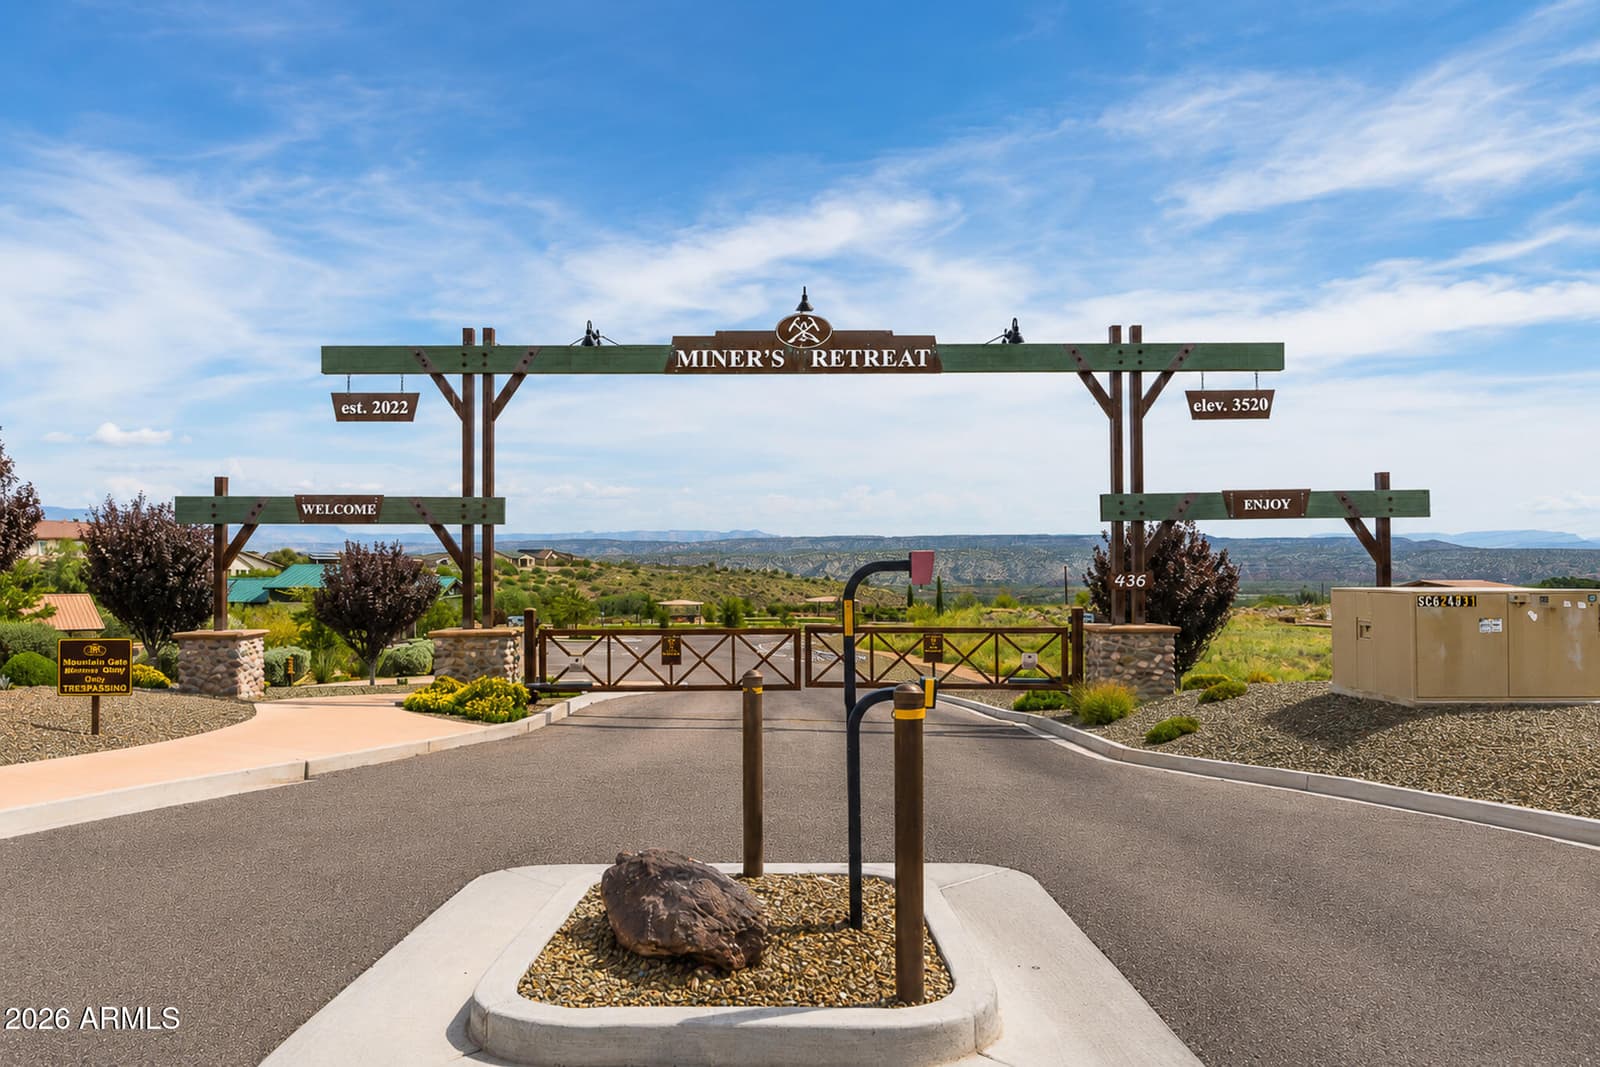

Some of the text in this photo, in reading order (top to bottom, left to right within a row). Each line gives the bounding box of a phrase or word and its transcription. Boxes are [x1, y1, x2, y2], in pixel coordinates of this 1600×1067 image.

[676, 349, 931, 368] MINER'S RETREAT
[341, 400, 408, 414] est. 2022
[1193, 397, 1268, 412] elev. 3520
[302, 503, 376, 515] WELCOME
[1244, 498, 1291, 510] ENJOY
[1114, 574, 1146, 587] 436
